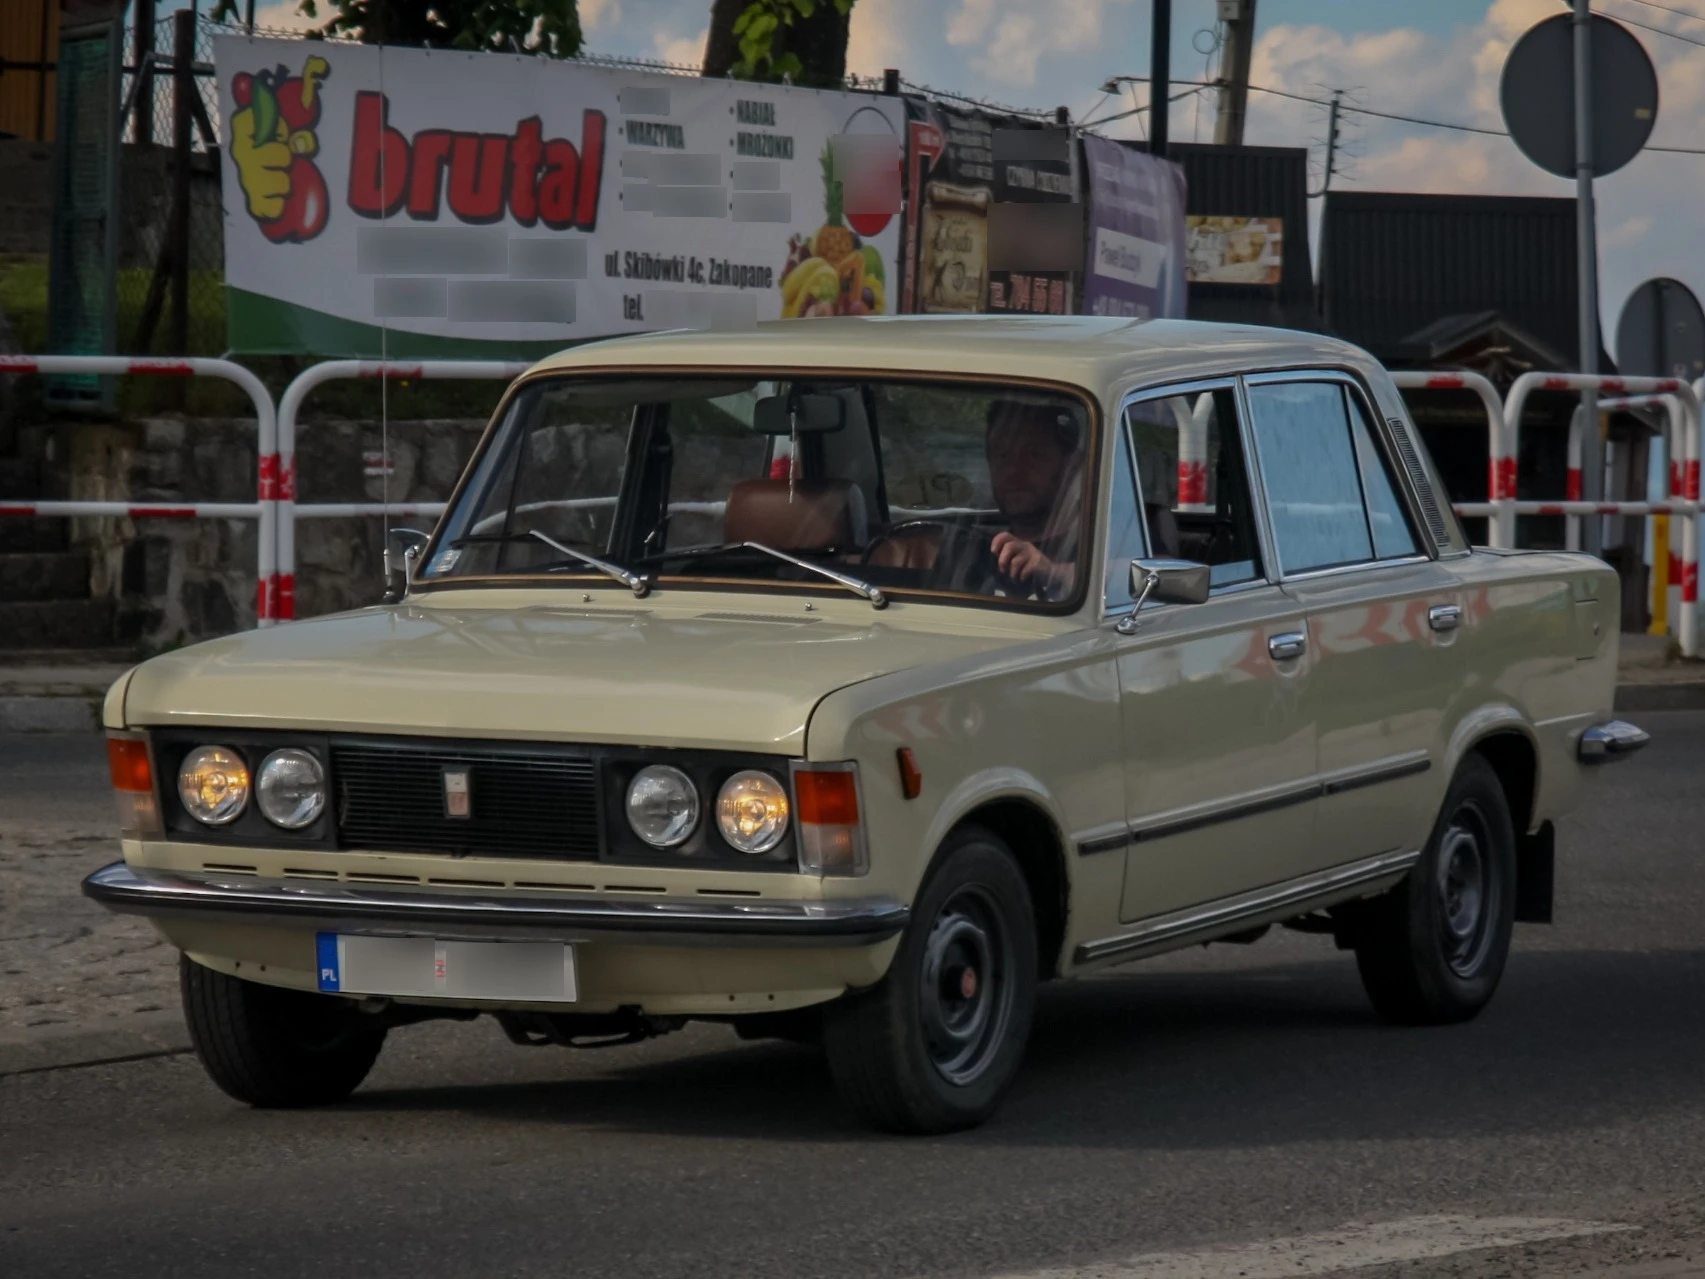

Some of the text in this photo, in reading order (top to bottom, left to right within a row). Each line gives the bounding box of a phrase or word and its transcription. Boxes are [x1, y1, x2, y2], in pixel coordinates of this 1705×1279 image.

[736, 100, 776, 127] NABIAŁ
[625, 119, 685, 150] WARZYWA
[737, 131, 793, 160] MROŻONKI
[347, 89, 607, 233] brutal
[604, 250, 621, 278] ul.
[624, 250, 685, 284] Skibówki
[708, 257, 773, 290] Zakopane
[623, 293, 645, 322] tel.
[321, 969, 337, 982] PL
